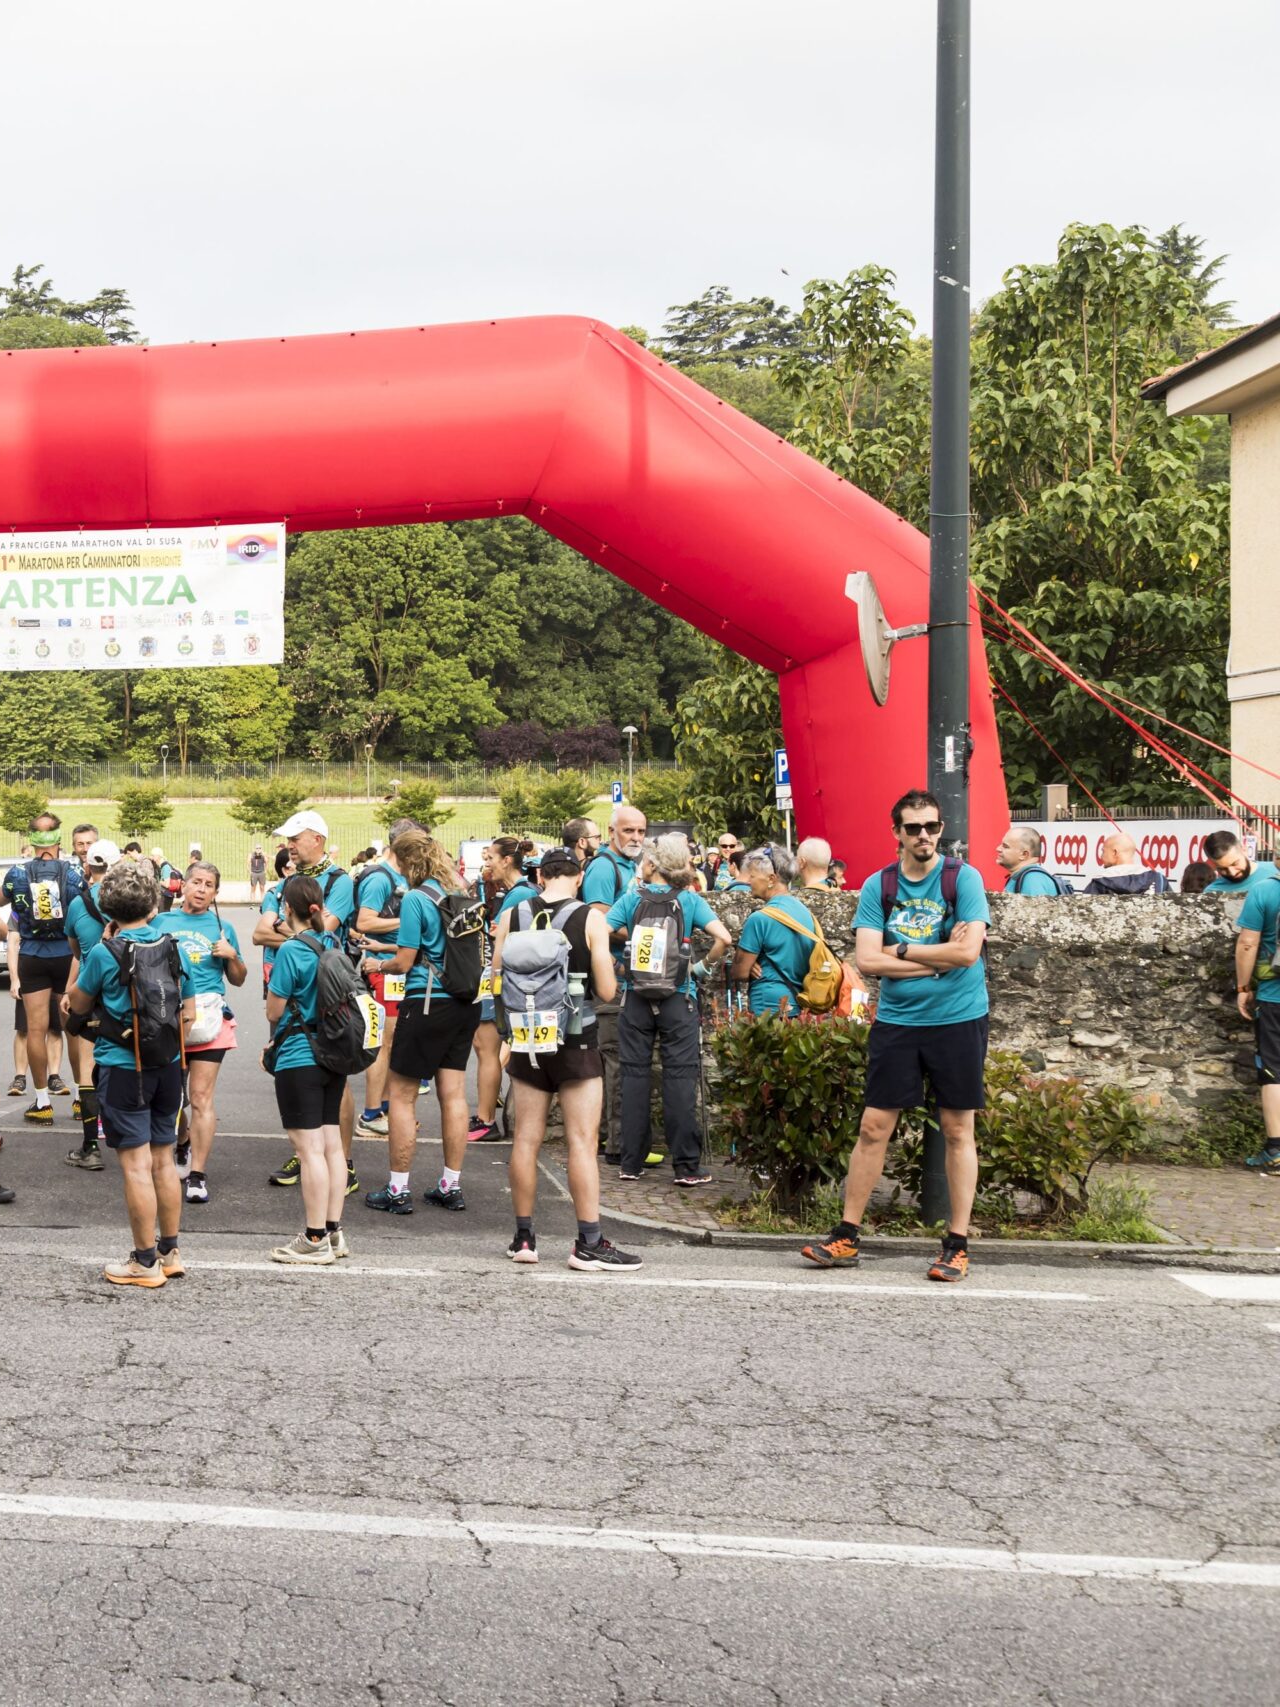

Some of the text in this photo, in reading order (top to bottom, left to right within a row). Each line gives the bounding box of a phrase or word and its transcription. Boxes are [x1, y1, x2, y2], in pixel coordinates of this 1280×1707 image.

[9, 541, 68, 550] FRANCIGENA
[71, 539, 123, 548] MARATHON
[126, 538, 142, 547] VAL
[146, 538, 155, 546] DI
[159, 537, 183, 546] SUSA
[238, 544, 266, 554] IRIDE
[66, 555, 80, 569] PER
[777, 753, 789, 782] P
[613, 783, 621, 802] P
[1055, 834, 1088, 873] coop
[1140, 834, 1179, 877] coop
[638, 934, 654, 964] 0928
[392, 982, 406, 993] 15
[520, 1026, 549, 1041] 149
